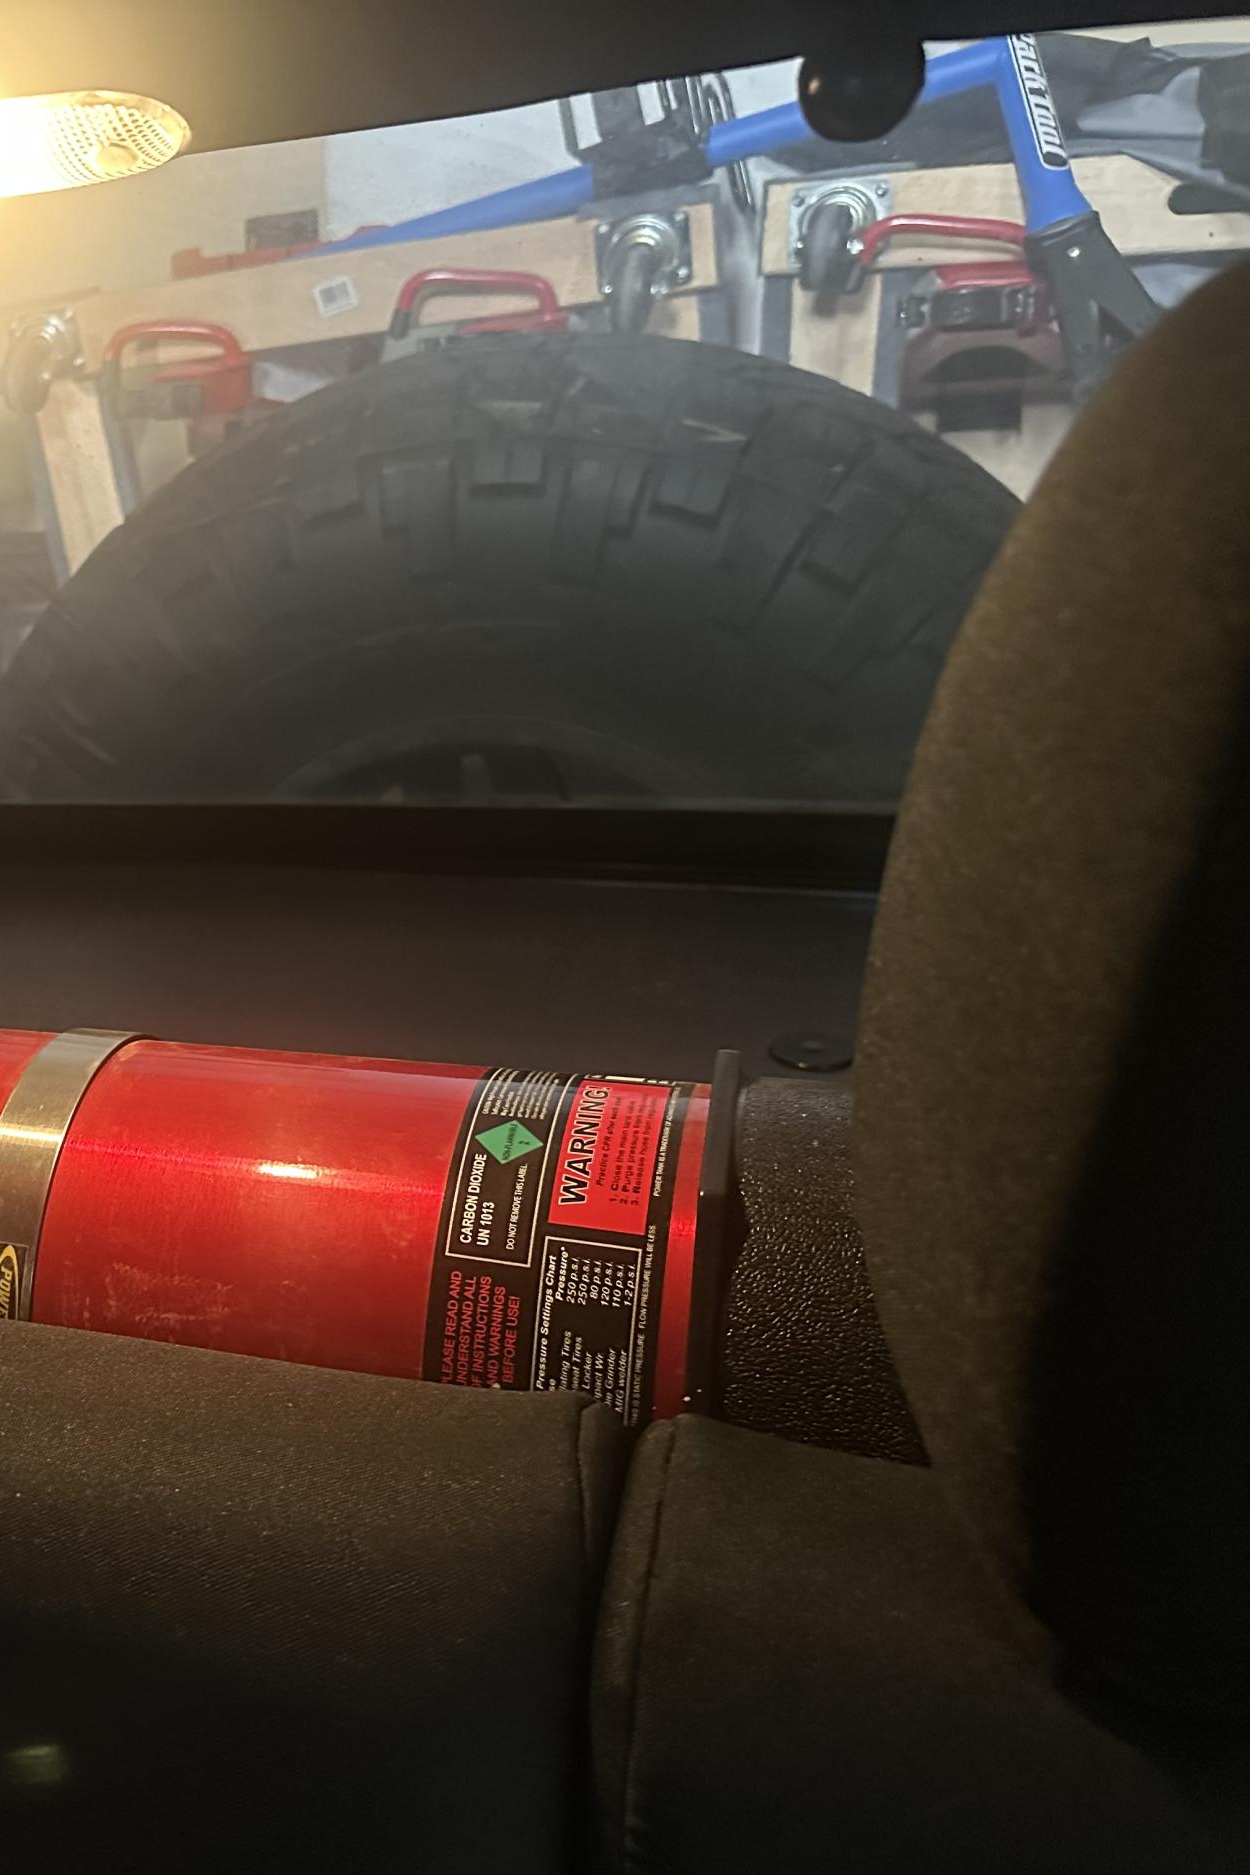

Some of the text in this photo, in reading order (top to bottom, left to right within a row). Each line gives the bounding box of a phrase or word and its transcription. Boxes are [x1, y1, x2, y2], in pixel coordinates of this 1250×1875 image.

[1029, 91, 1067, 158] Tool
[558, 1085, 611, 1205] WARNING!
[615, 1150, 625, 1163] the
[627, 1126, 640, 1163] pressure
[514, 1182, 524, 1196] THIS
[610, 1164, 623, 1191] Close
[622, 1165, 635, 1193] Purge
[632, 1157, 646, 1194] Release
[653, 1176, 662, 1197] POWER
[459, 1153, 487, 1244] CARBON DIOXIDE
[511, 1195, 523, 1223] REMOVE
[477, 1201, 495, 1246] UN 1013
[508, 1223, 518, 1238] NOT
[647, 1224, 657, 1242] LESS
[506, 1239, 515, 1250] DO
[448, 1270, 462, 1299] AND
[566, 1283, 578, 1304] 250
[577, 1284, 588, 1306] 250
[623, 1289, 633, 1307] 1-2
[640, 1269, 652, 1307] PRESSURE
[444, 1300, 459, 1337] READ
[456, 1276, 477, 1386] UNDERSTAND ALL
[472, 1275, 492, 1373] INSTRUCTIONS
[535, 1255, 557, 1390] Pressure Settings Chart
[638, 1307, 648, 1329] FLOW
[486, 1286, 507, 1386] AND WARNINGS
[502, 1295, 521, 1384] BEFORE USE!
[562, 1330, 572, 1358] Tires
[572, 1336, 583, 1364] Tires
[581, 1351, 593, 1390] Locker
[589, 1285, 599, 1299] 80
[594, 1371, 605, 1399] pact
[600, 1287, 611, 1307] 120
[604, 1347, 617, 1390] Grinder
[612, 1290, 622, 1309] 110
[559, 1360, 570, 1391] lating
[572, 1366, 581, 1390] seat
[617, 1349, 628, 1388] welder
[614, 1389, 625, 1414] MIG
